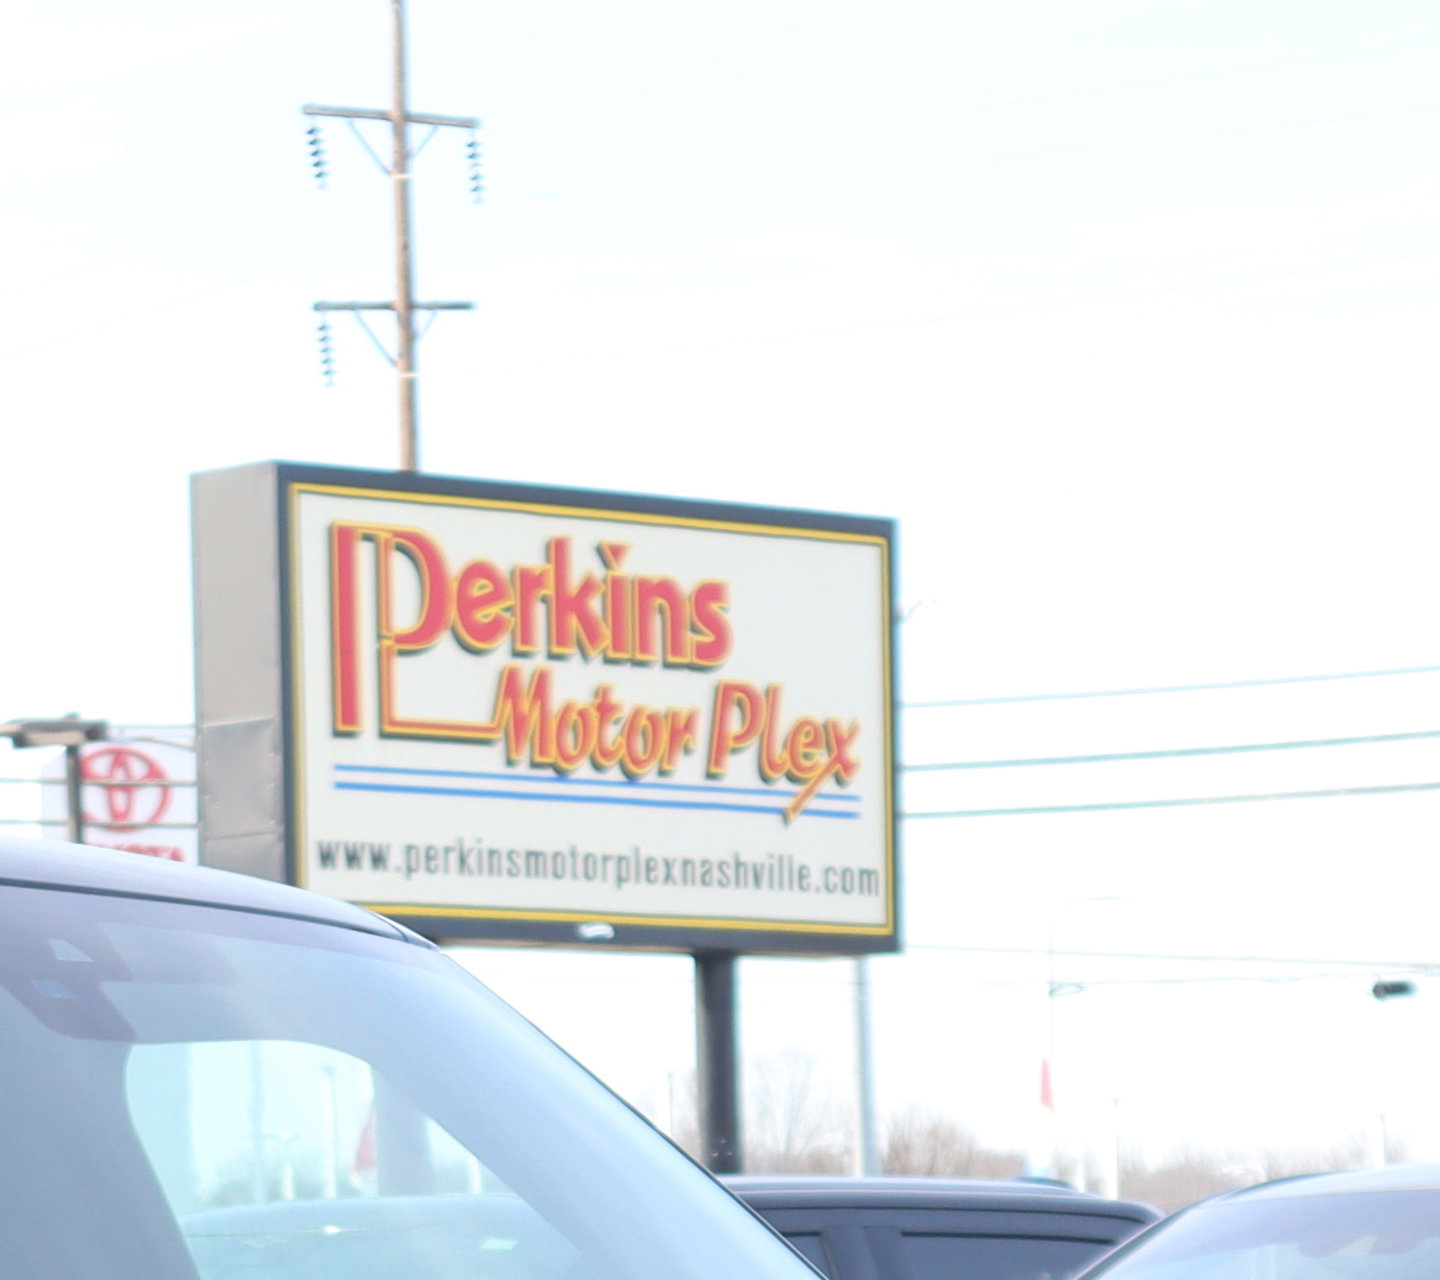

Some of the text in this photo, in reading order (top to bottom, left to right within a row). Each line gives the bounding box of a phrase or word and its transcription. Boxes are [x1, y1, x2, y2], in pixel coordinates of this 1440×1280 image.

[330, 520, 734, 735] Perkins
[494, 664, 862, 822] Motor Plex
[316, 838, 881, 897] www.perkinsmotorplexnashville.com
